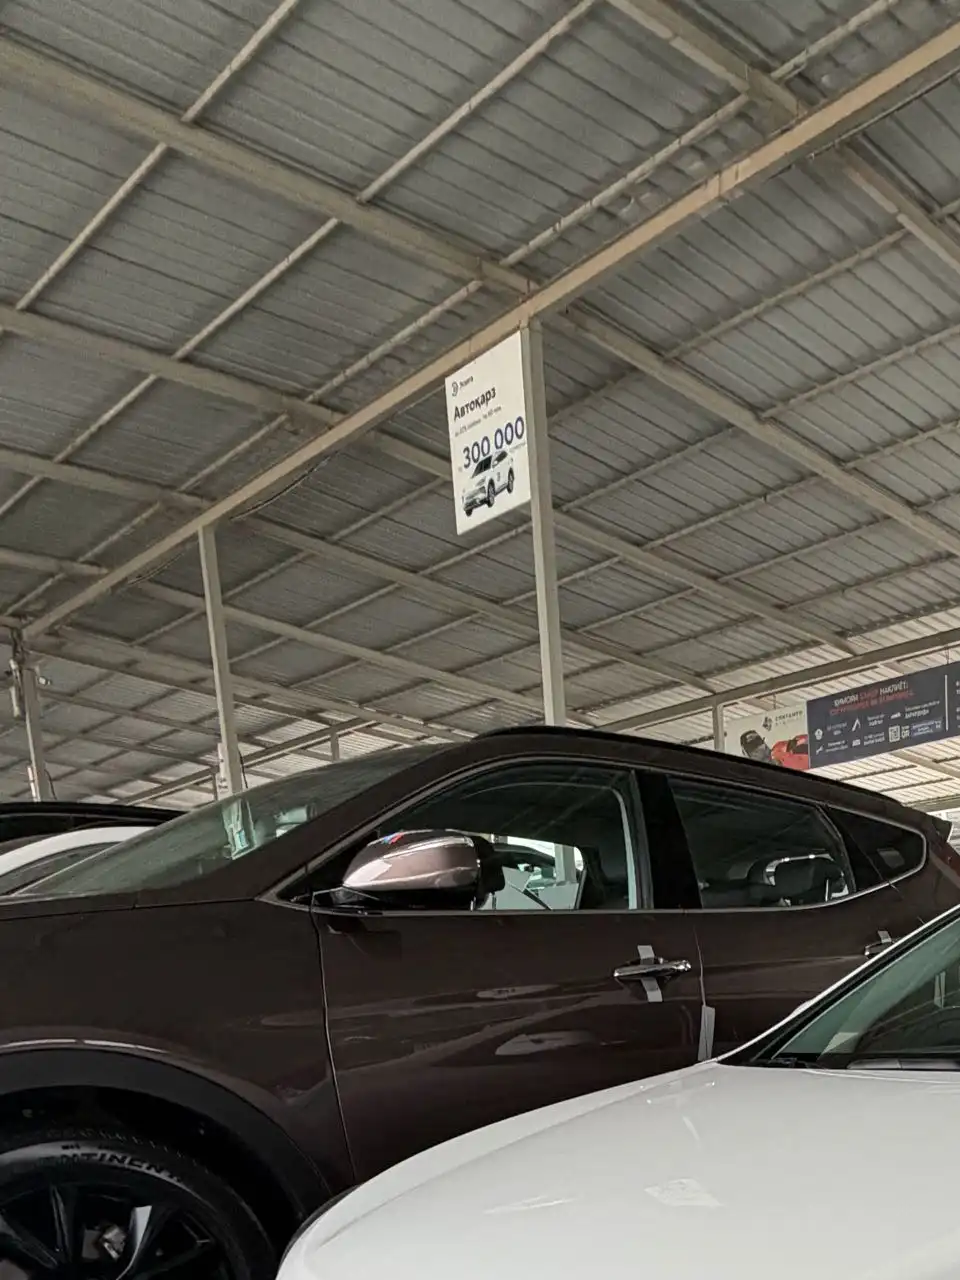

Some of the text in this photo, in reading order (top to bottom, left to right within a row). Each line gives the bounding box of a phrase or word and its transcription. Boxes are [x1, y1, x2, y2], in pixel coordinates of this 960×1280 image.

[454, 387, 496, 422] Автоқарз
[462, 436, 490, 468] 300
[494, 416, 525, 450] 000
